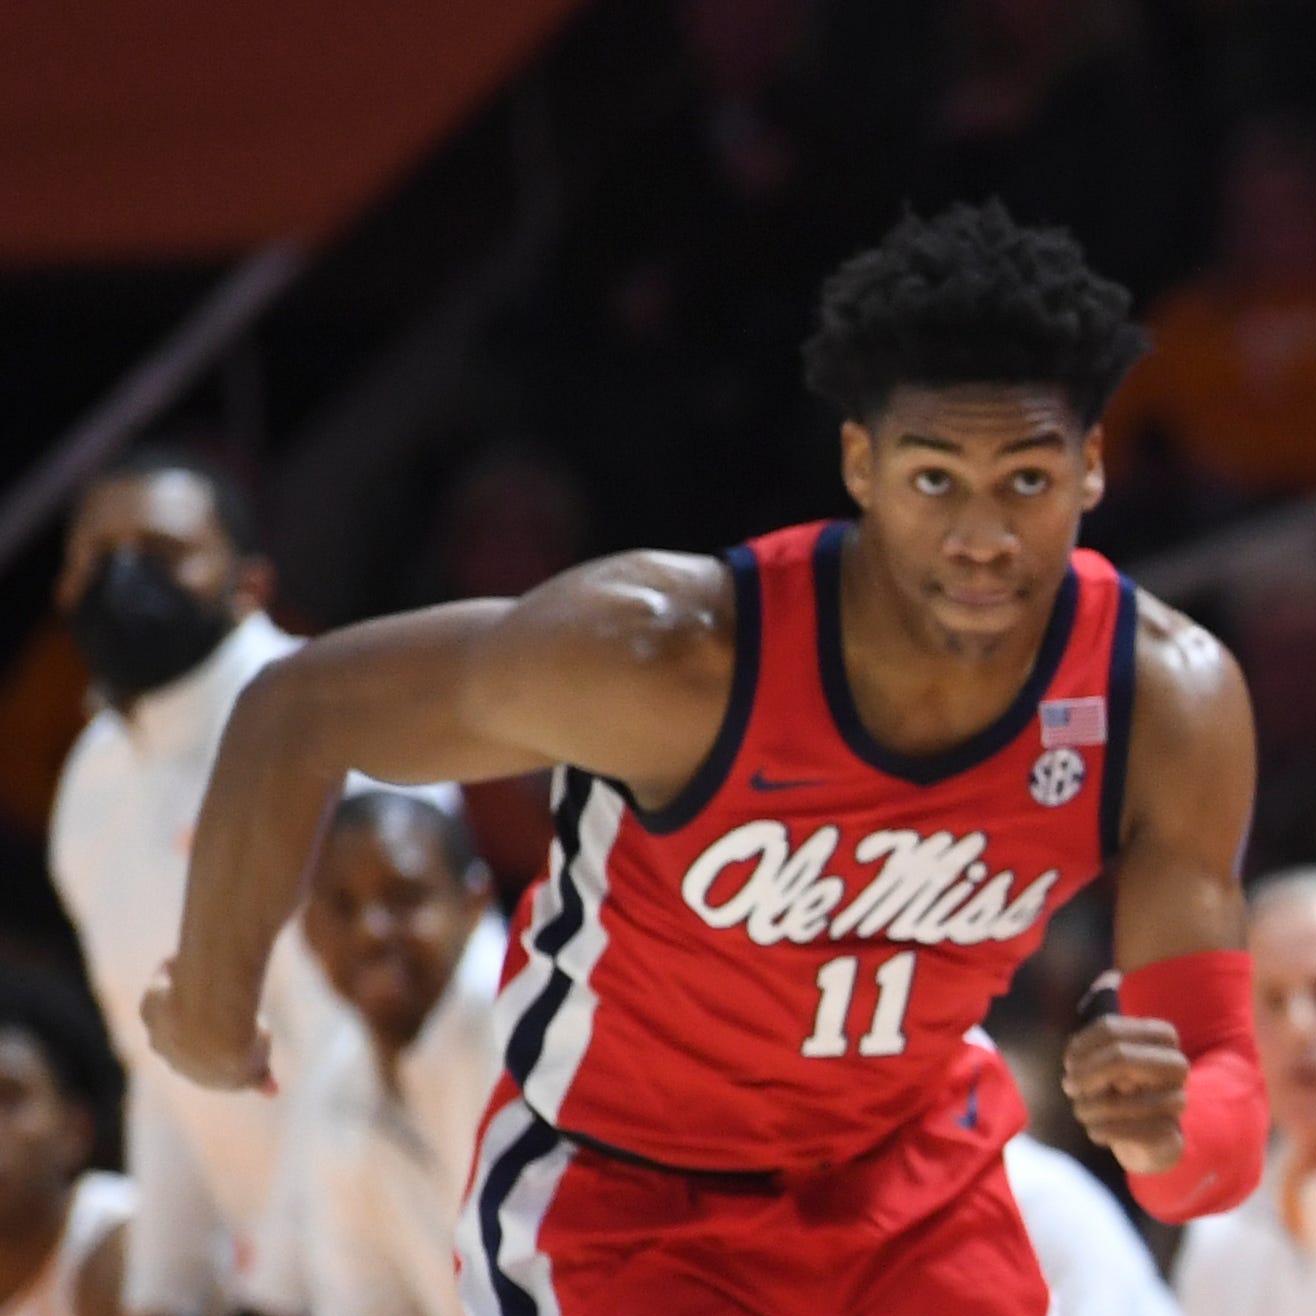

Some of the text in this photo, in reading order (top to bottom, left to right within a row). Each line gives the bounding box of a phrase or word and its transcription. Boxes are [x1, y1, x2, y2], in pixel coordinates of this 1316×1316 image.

[682, 819, 1059, 945] Ole Miss
[801, 951, 916, 1059] 11
